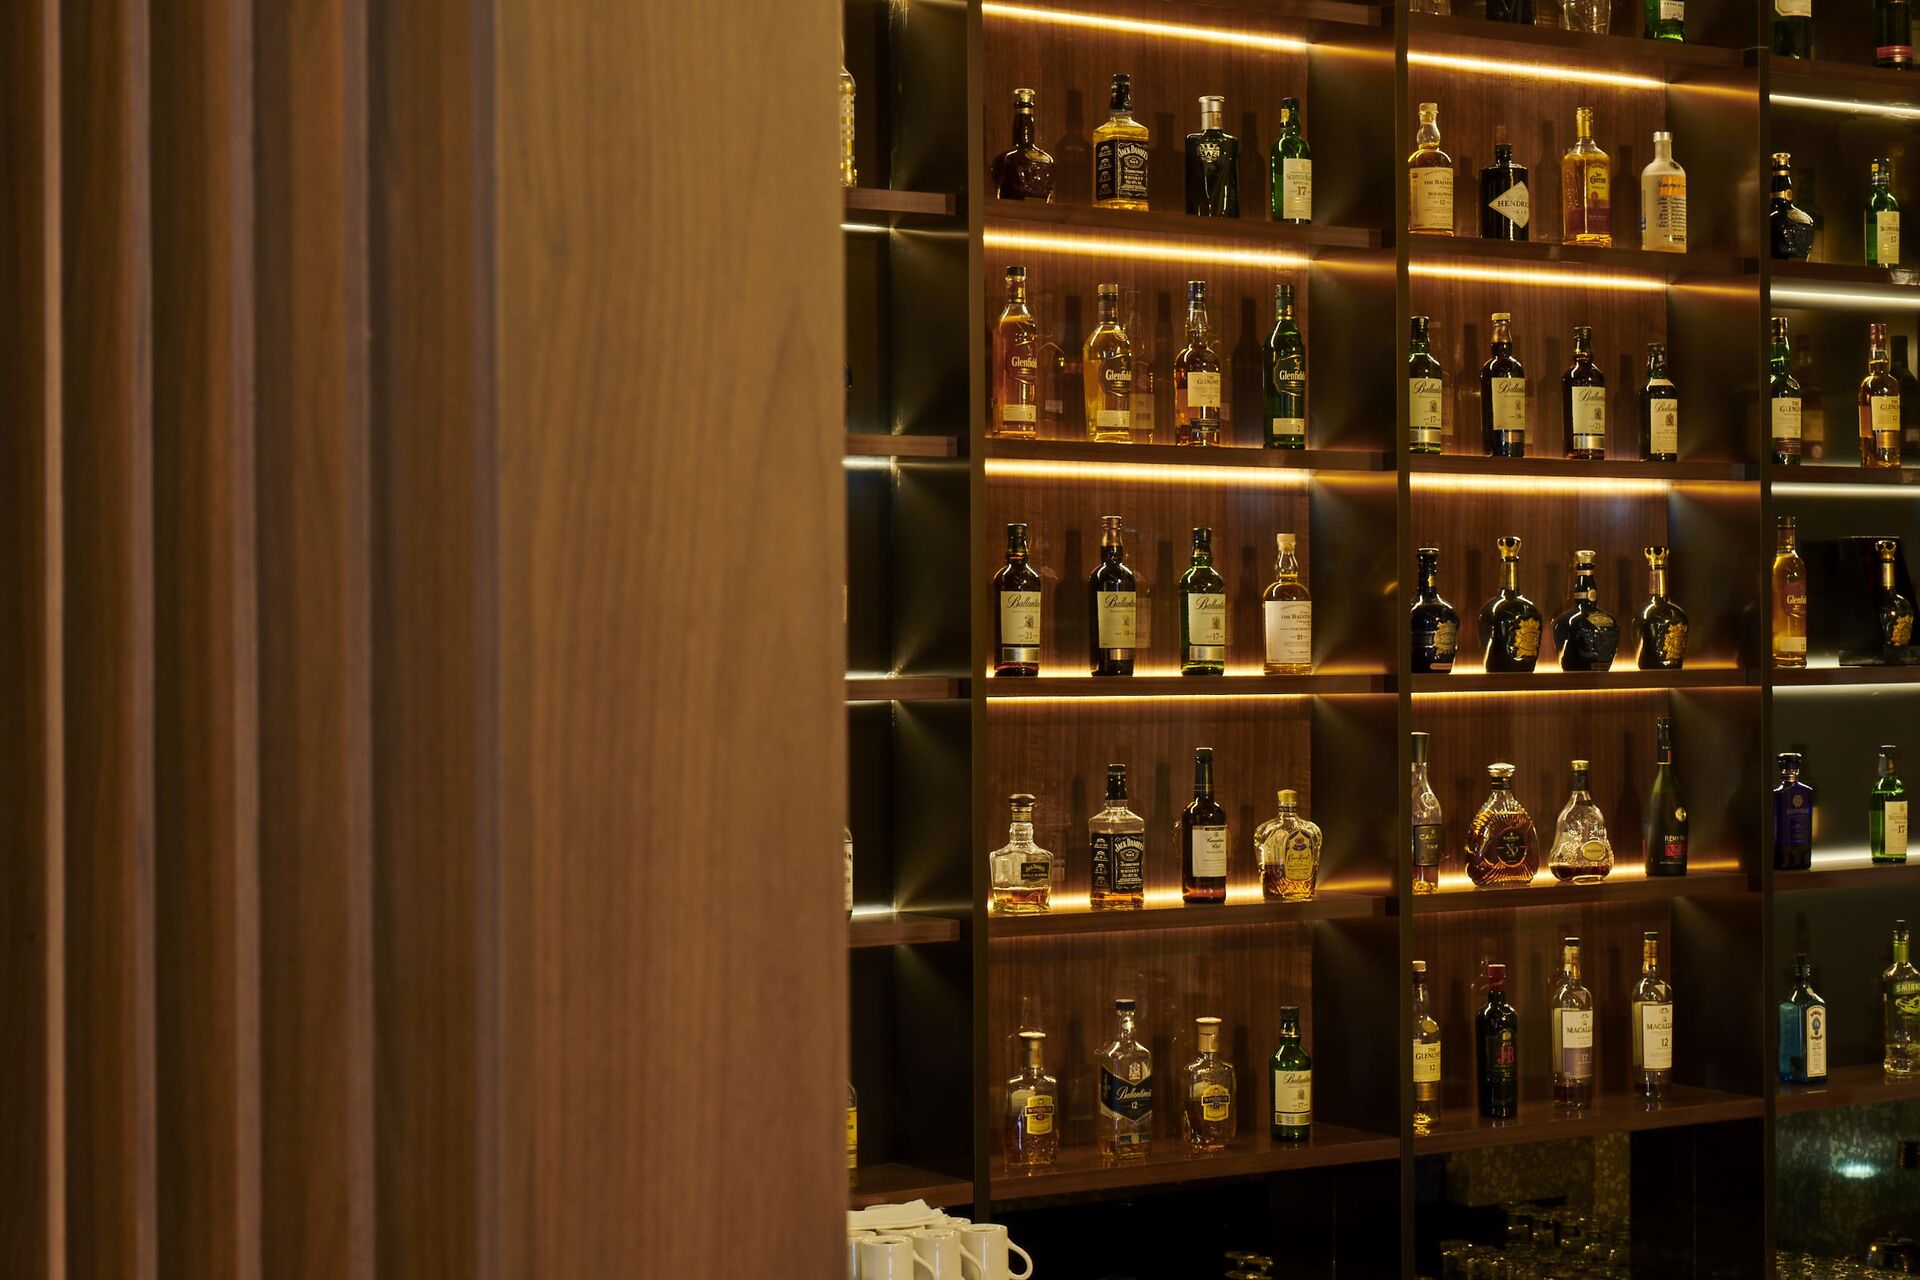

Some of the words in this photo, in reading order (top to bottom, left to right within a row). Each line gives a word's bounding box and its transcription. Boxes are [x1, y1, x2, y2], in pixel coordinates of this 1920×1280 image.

[1297, 187, 1307, 196] 17
[1430, 415, 1437, 423] 17
[1025, 631, 1033, 640] 21
[1212, 632, 1220, 641] 17
[1897, 824, 1905, 834] 17
[1661, 1037, 1669, 1047] 12
[1131, 1101, 1139, 1109] 12
